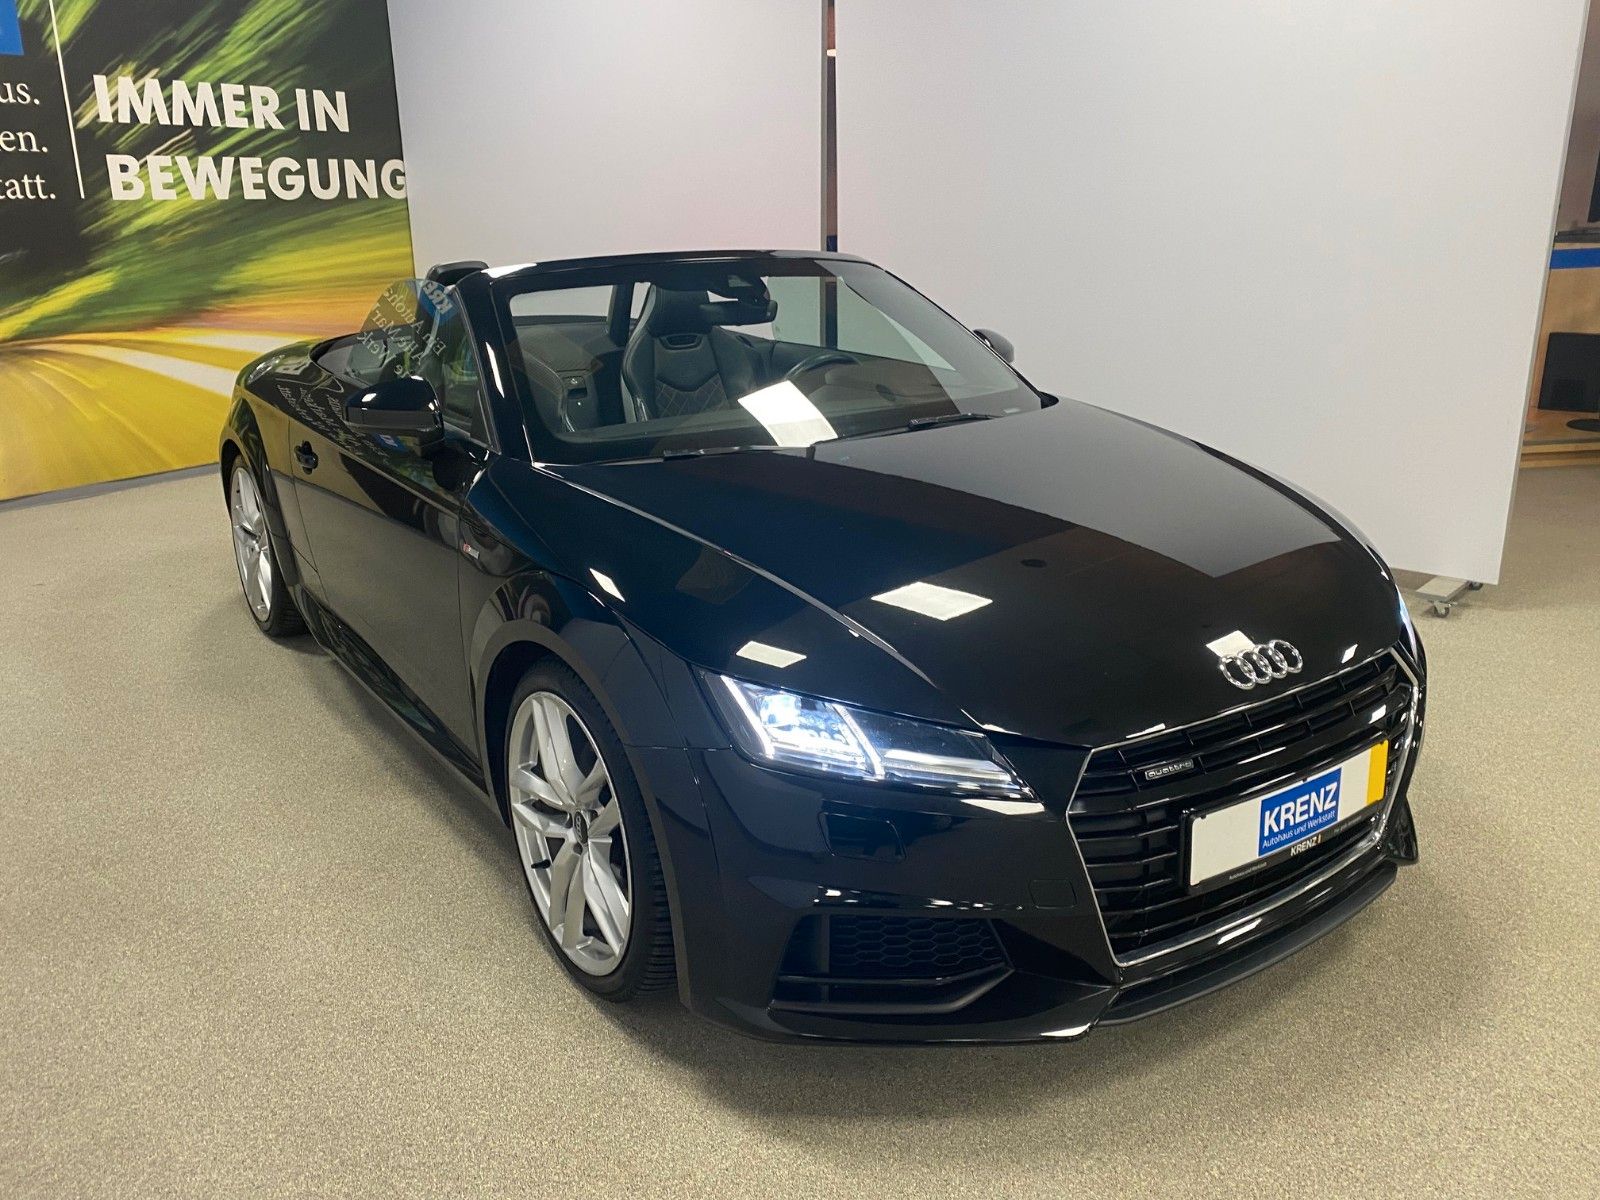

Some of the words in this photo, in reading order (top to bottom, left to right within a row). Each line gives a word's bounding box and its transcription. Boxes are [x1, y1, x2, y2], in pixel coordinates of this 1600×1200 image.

[93, 74, 285, 130] IMMER
[295, 88, 350, 132] IN
[105, 154, 407, 200] BEWEGUNG
[1147, 761, 1192, 778] quattro
[1262, 829, 1294, 849] Autohaus
[1294, 823, 1307, 836] und
[1307, 811, 1336, 829] Werkstatt
[1264, 782, 1338, 837] KRENZ
[1290, 836, 1317, 857] KRENZ
